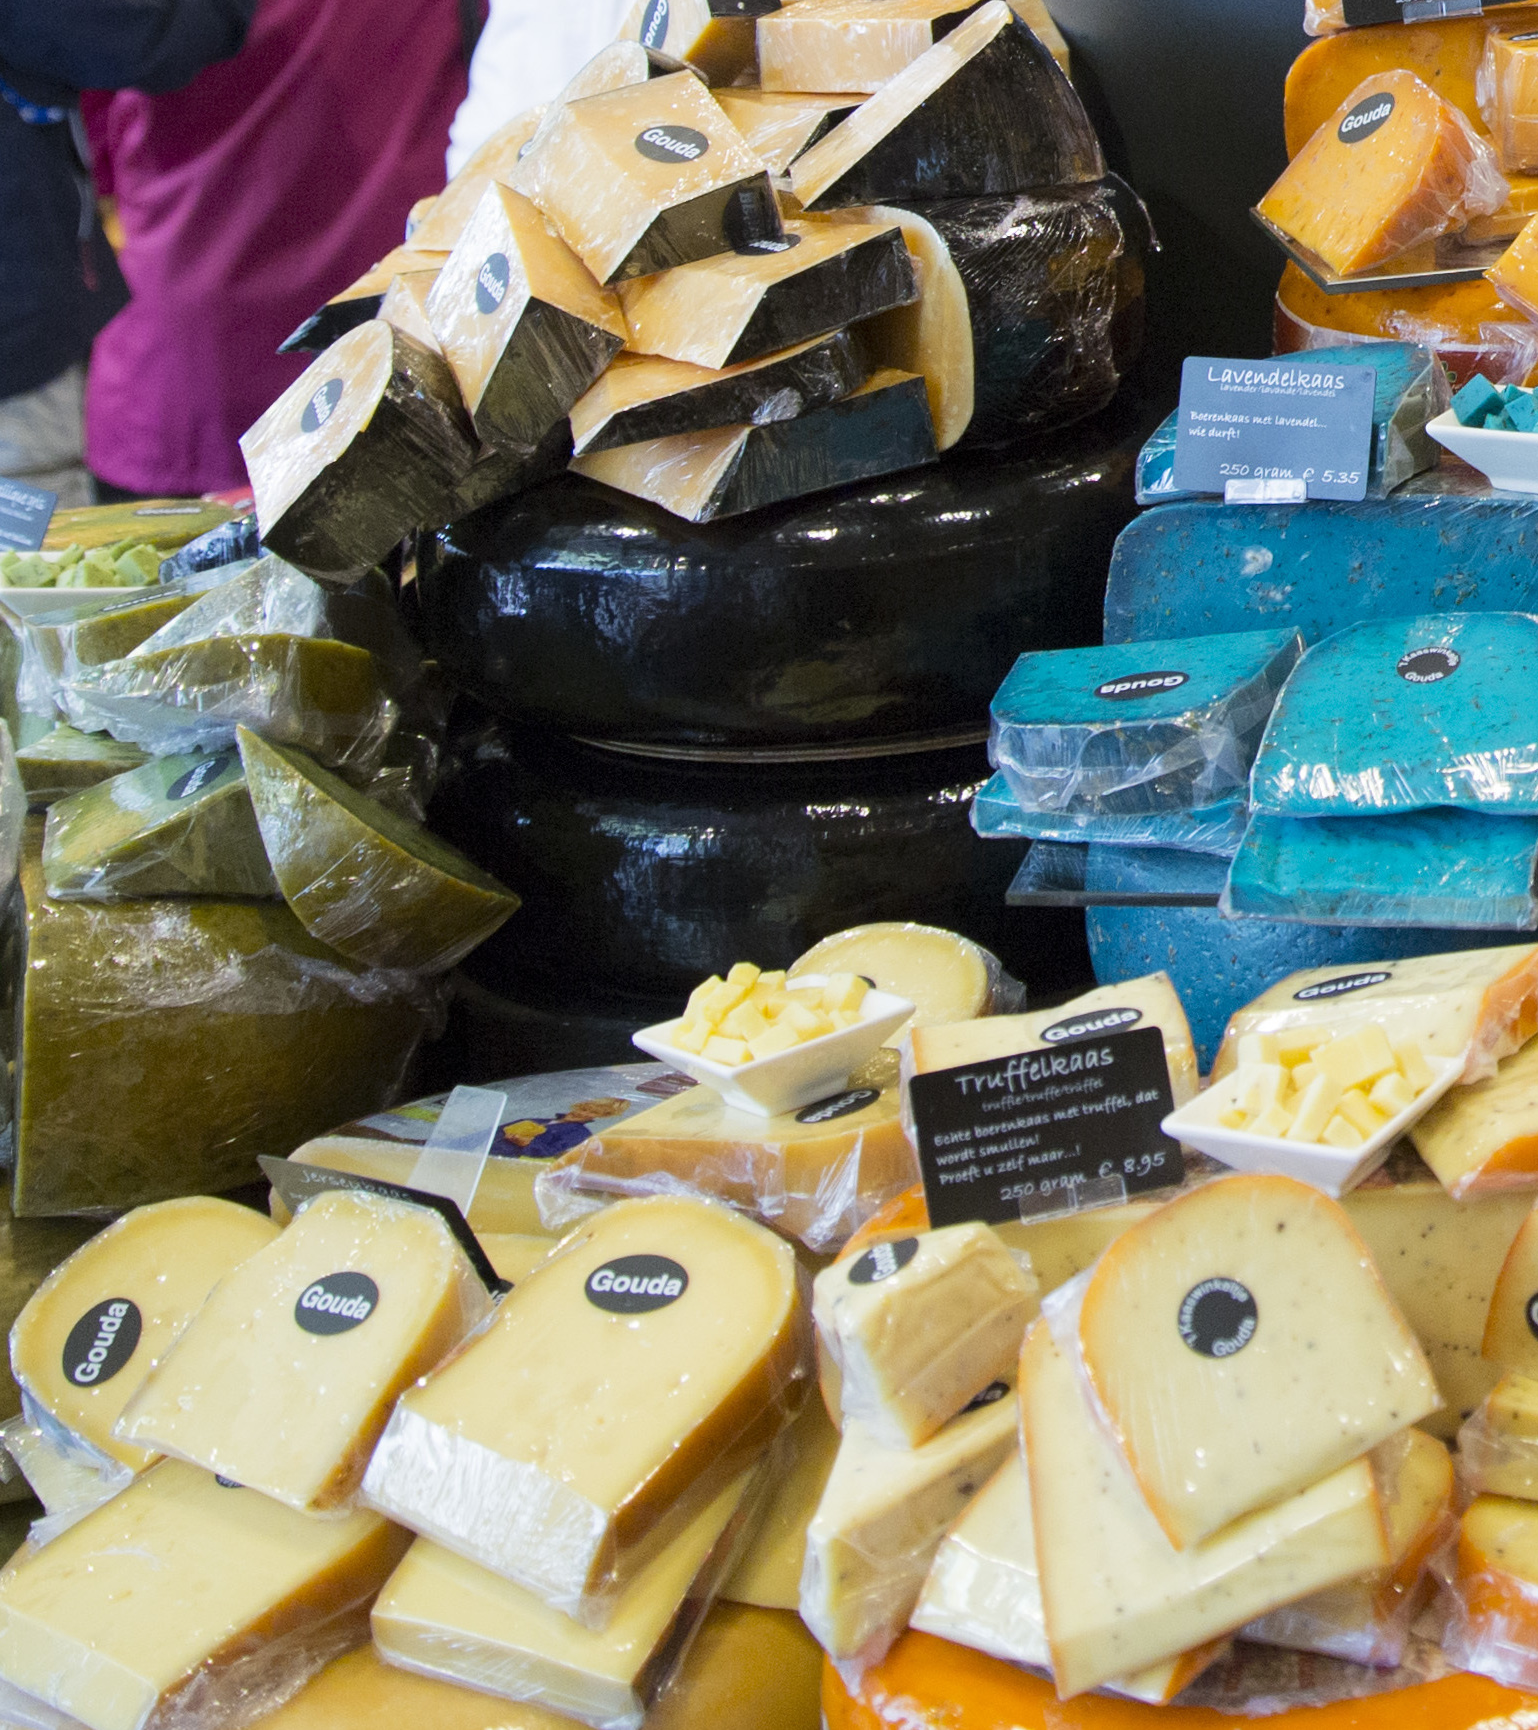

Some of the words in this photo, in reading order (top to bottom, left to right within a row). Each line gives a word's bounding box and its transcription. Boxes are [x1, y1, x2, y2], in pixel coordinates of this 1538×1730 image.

[1341, 103, 1391, 133] Gouda
[642, 130, 699, 160] Gouda
[1207, 366, 1345, 390] Lavendelkaas
[1188, 425, 1206, 437] wie
[1208, 427, 1240, 441] durft!
[1190, 411, 1250, 425] Boerenkaas
[1252, 415, 1272, 426] met
[1219, 463, 1249, 476] 250
[1253, 465, 1293, 479] gram
[1302, 467, 1315, 483] €
[1321, 470, 1361, 484] 5.35
[1100, 675, 1184, 694] Gouda
[1296, 973, 1388, 999] Gouda
[1045, 1010, 1139, 1042] Gouda
[955, 1047, 1114, 1095] Truffelkaas
[802, 1090, 873, 1123] Gouda
[933, 1130, 972, 1146] Echte
[974, 1114, 1050, 1138] boerenkaas
[1053, 1107, 1079, 1121] met
[1083, 1094, 1132, 1116] truffel,
[1135, 1089, 1159, 1103] dat
[936, 1147, 976, 1166] wordt
[979, 1134, 1039, 1157] smullen!
[939, 1165, 981, 1185] Proeft
[983, 1165, 993, 1175] u
[996, 1156, 1025, 1173] zelf
[1000, 1183, 1035, 1201] 250
[1039, 1173, 1087, 1197] gram
[1099, 1162, 1113, 1178] €
[1123, 1151, 1166, 1177] 8.95
[590, 1270, 683, 1297] Gouda
[301, 1285, 371, 1321] Gouda
[73, 1302, 130, 1382] Gouda
